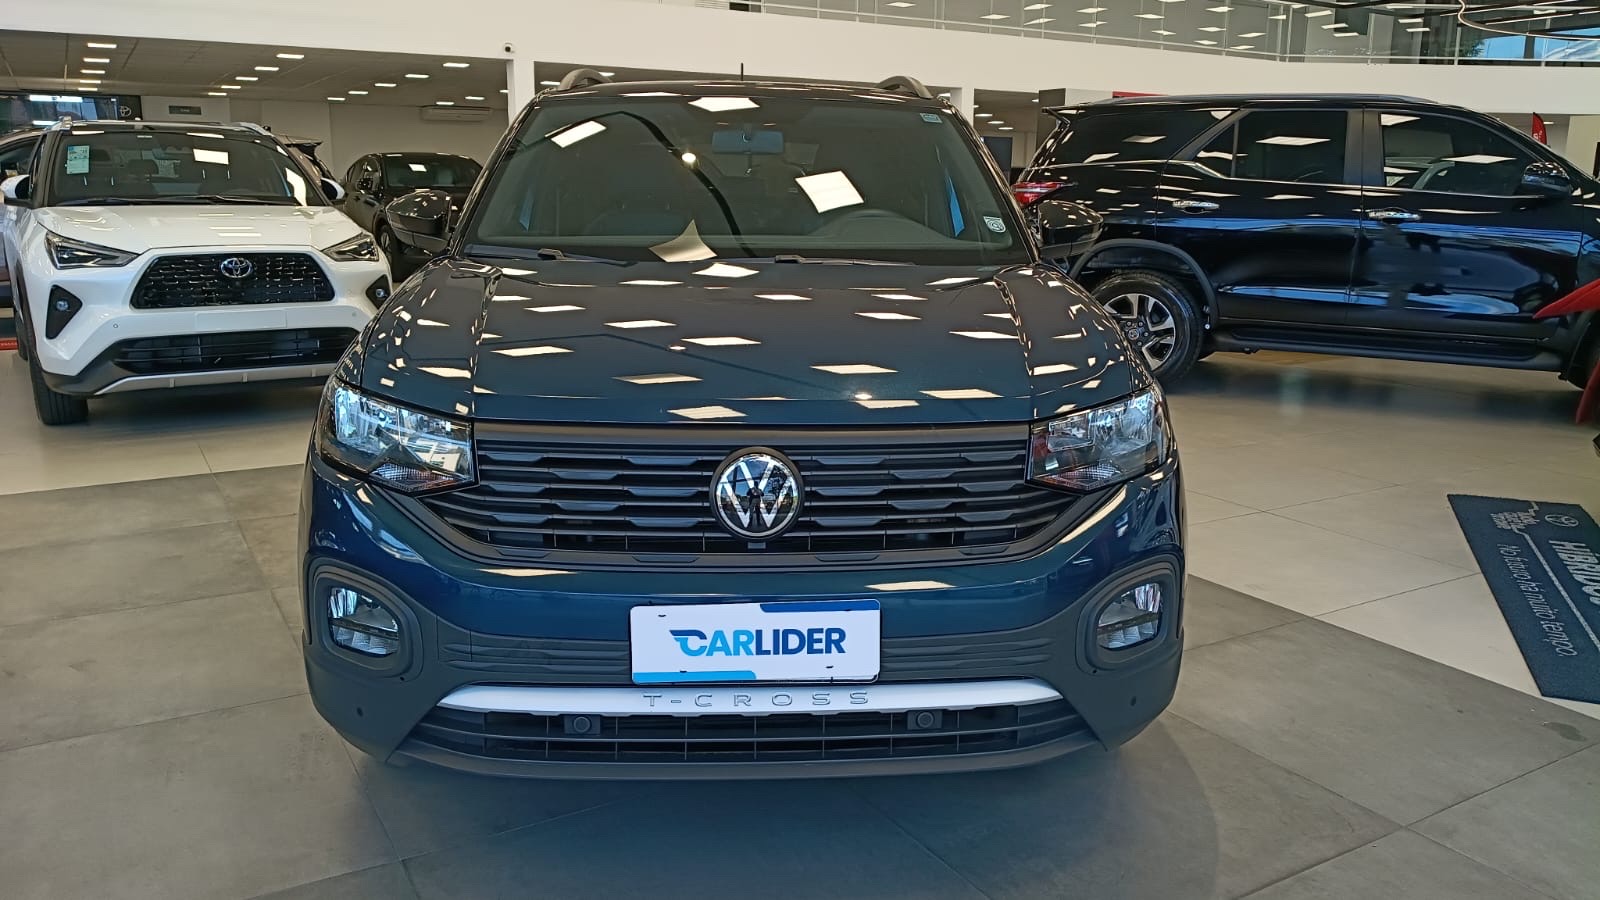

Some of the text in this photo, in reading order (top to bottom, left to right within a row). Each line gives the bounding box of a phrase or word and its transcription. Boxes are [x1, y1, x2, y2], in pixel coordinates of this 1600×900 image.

[1548, 540, 1600, 606] HÍBRID
[1523, 592, 1558, 619] muito
[669, 627, 847, 657] CARLIDER
[643, 690, 869, 707] T-CROSS
